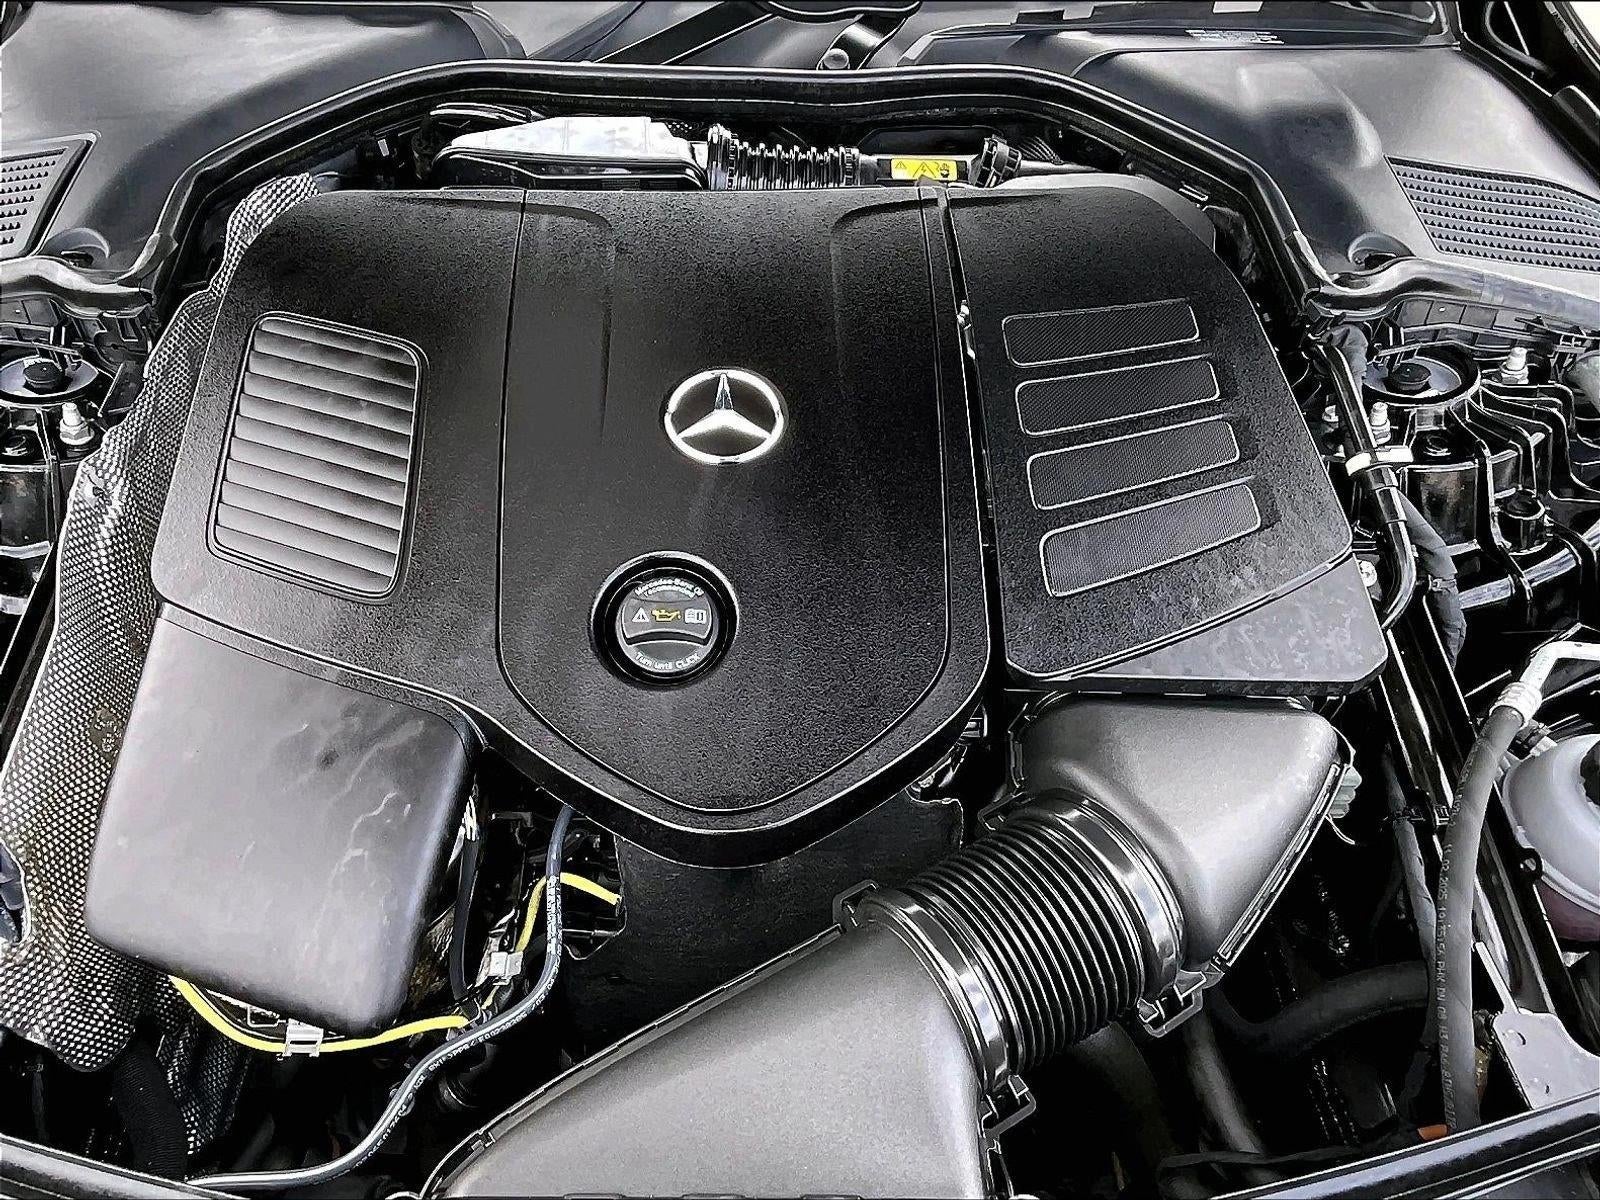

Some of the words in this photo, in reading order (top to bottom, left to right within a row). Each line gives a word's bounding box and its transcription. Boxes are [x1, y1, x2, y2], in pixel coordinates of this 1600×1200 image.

[634, 578, 695, 596] Mercedes-Benz
[635, 651, 653, 667] Turn
[675, 652, 701, 669] CLICK
